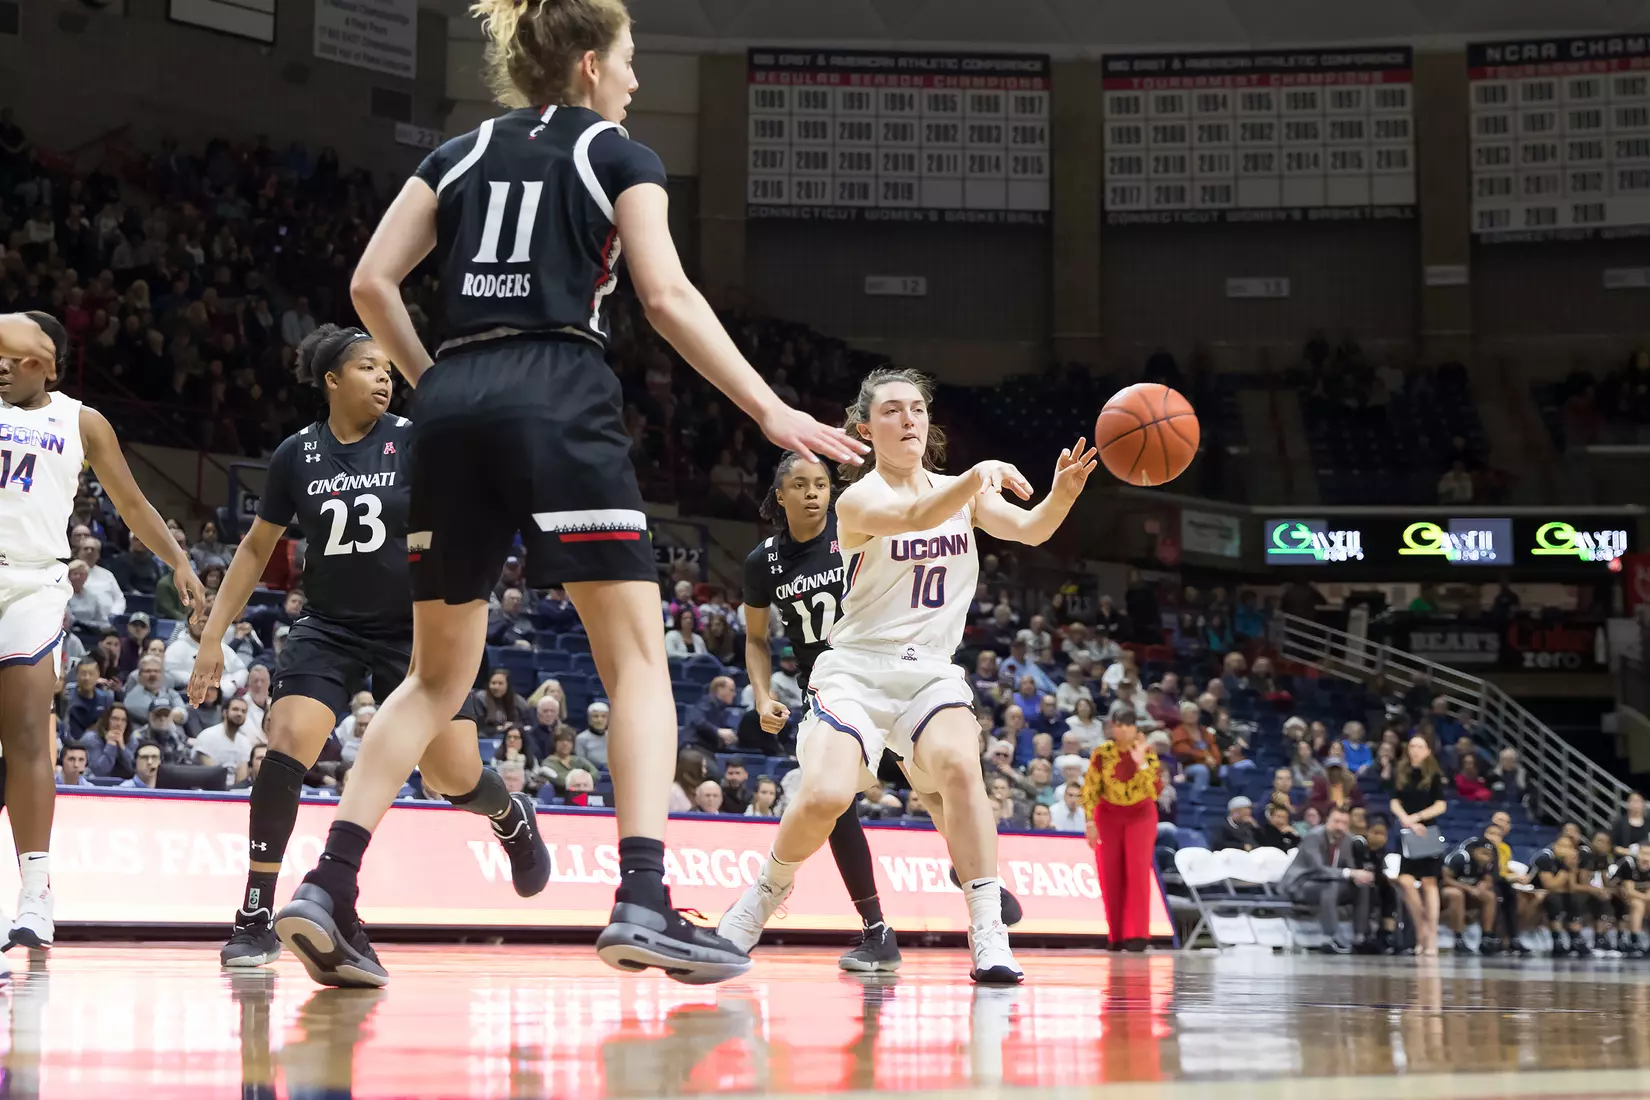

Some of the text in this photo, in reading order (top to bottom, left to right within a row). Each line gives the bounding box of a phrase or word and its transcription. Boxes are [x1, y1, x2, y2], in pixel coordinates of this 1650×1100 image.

[1486, 37, 1650, 62] NCAA CHAM
[755, 72, 1043, 88] REGULAR SEASON CHAMPIONS
[1132, 72, 1383, 88] TOURNAMENT CHAMPIONS
[472, 181, 544, 264] 11
[749, 207, 857, 220] CONNECTICUT
[461, 272, 531, 298] RODGERS
[902, 279, 920, 293] 12
[0, 423, 65, 455] CONN
[303, 440, 318, 451] RJ
[0, 449, 37, 493] 14
[307, 472, 397, 496] CINCINNATI
[320, 493, 387, 556] 23
[768, 551, 779, 562] RJ
[890, 533, 968, 561] UCONN
[776, 566, 844, 600] CINCINNAT
[911, 565, 948, 609] 10
[792, 592, 837, 644] 12
[1522, 651, 1582, 669] zero
[50, 827, 325, 878] LLS FARO
[468, 840, 768, 887] WLLS ARGO
[878, 855, 1102, 899] WEL FARG
